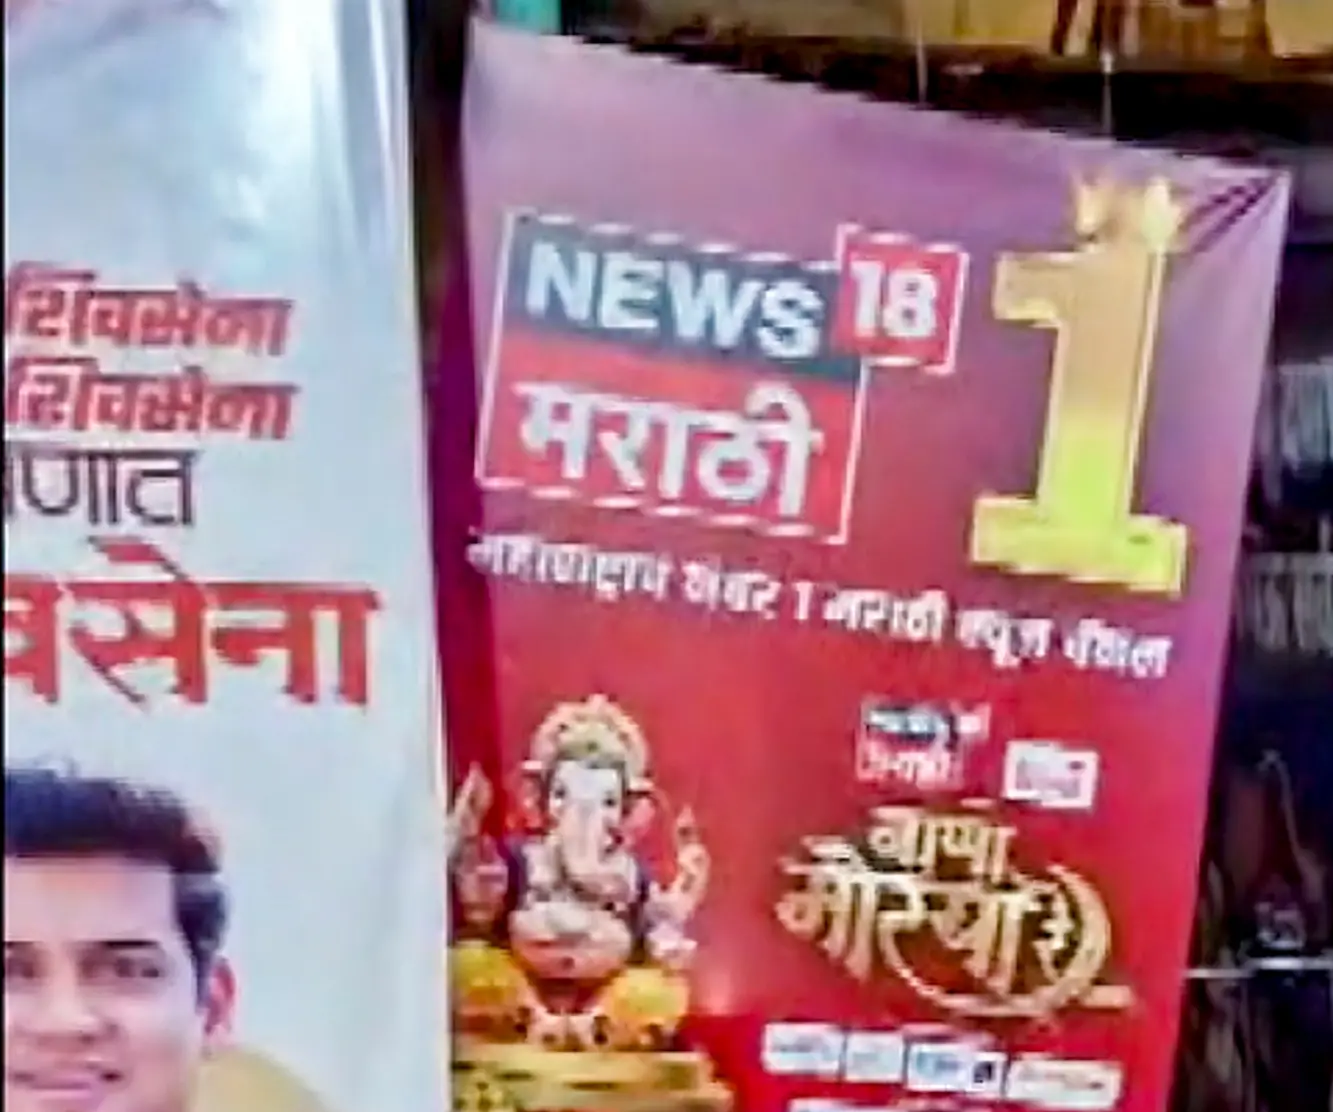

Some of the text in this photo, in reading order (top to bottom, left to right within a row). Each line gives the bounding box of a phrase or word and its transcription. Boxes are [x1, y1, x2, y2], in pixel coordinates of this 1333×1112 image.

[525, 242, 940, 360] NEWS 18
[513, 378, 825, 517] मराठी
